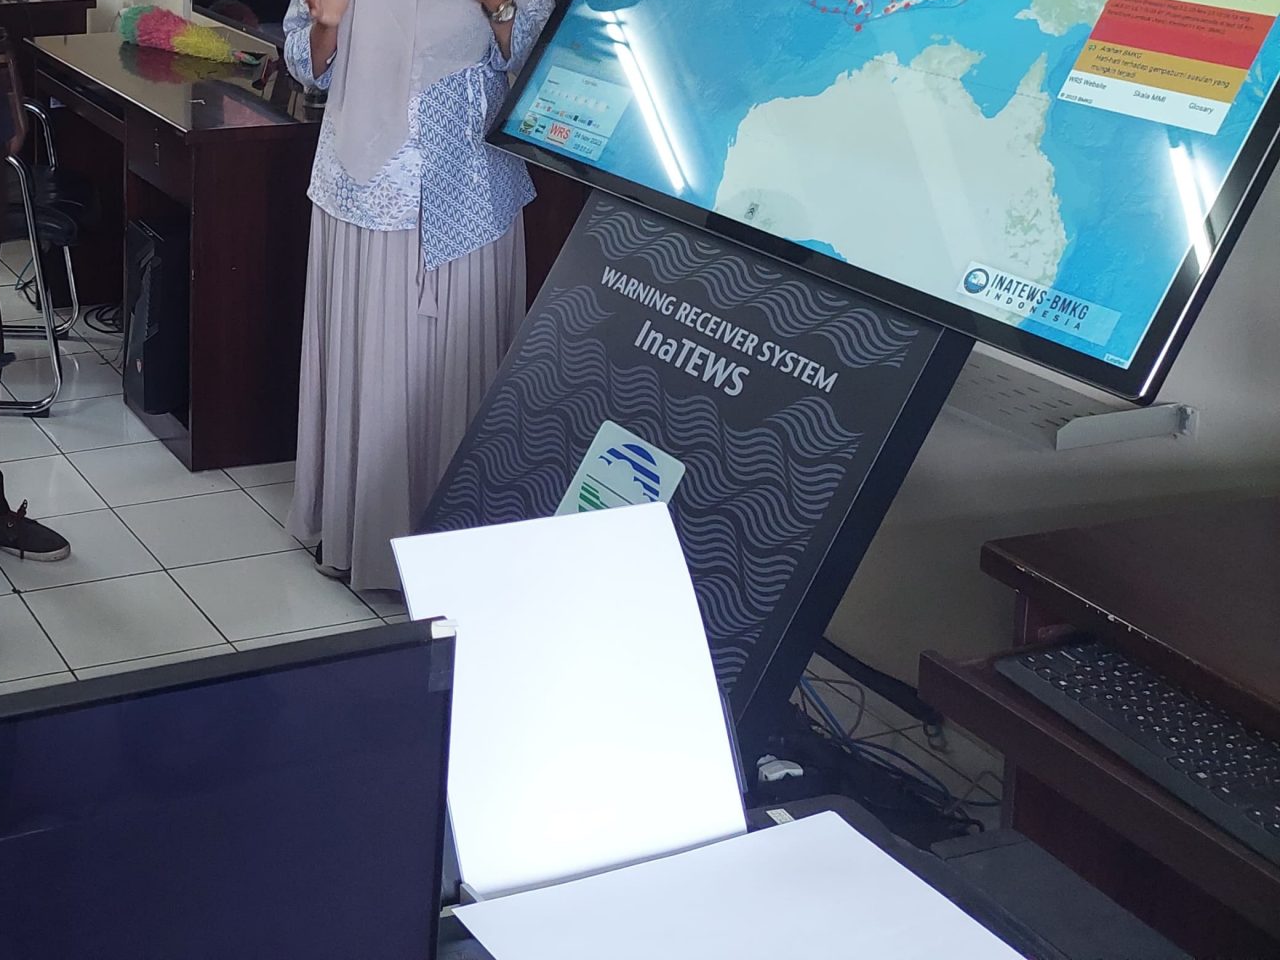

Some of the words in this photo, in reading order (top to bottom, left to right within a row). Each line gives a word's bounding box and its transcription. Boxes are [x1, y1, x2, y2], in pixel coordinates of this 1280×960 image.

[1122, 49, 1143, 59] BMKG
[1091, 64, 1116, 76] mungkin
[1120, 59, 1148, 72] terhadap
[1212, 79, 1230, 89] yang
[1068, 76, 1083, 85] WRS
[1083, 78, 1107, 90] Website
[1133, 90, 1150, 100] Skala
[1151, 93, 1167, 103] MMI
[1188, 102, 1214, 115] Glosary
[549, 122, 571, 140] WRS
[990, 273, 1089, 320] INATEWS-BMKG
[985, 290, 1081, 331] INDONESIA
[600, 266, 677, 316] WARNING
[675, 302, 760, 356] RECEIVER
[756, 341, 839, 393] SYSTEM
[633, 319, 751, 397] InaTEWS
